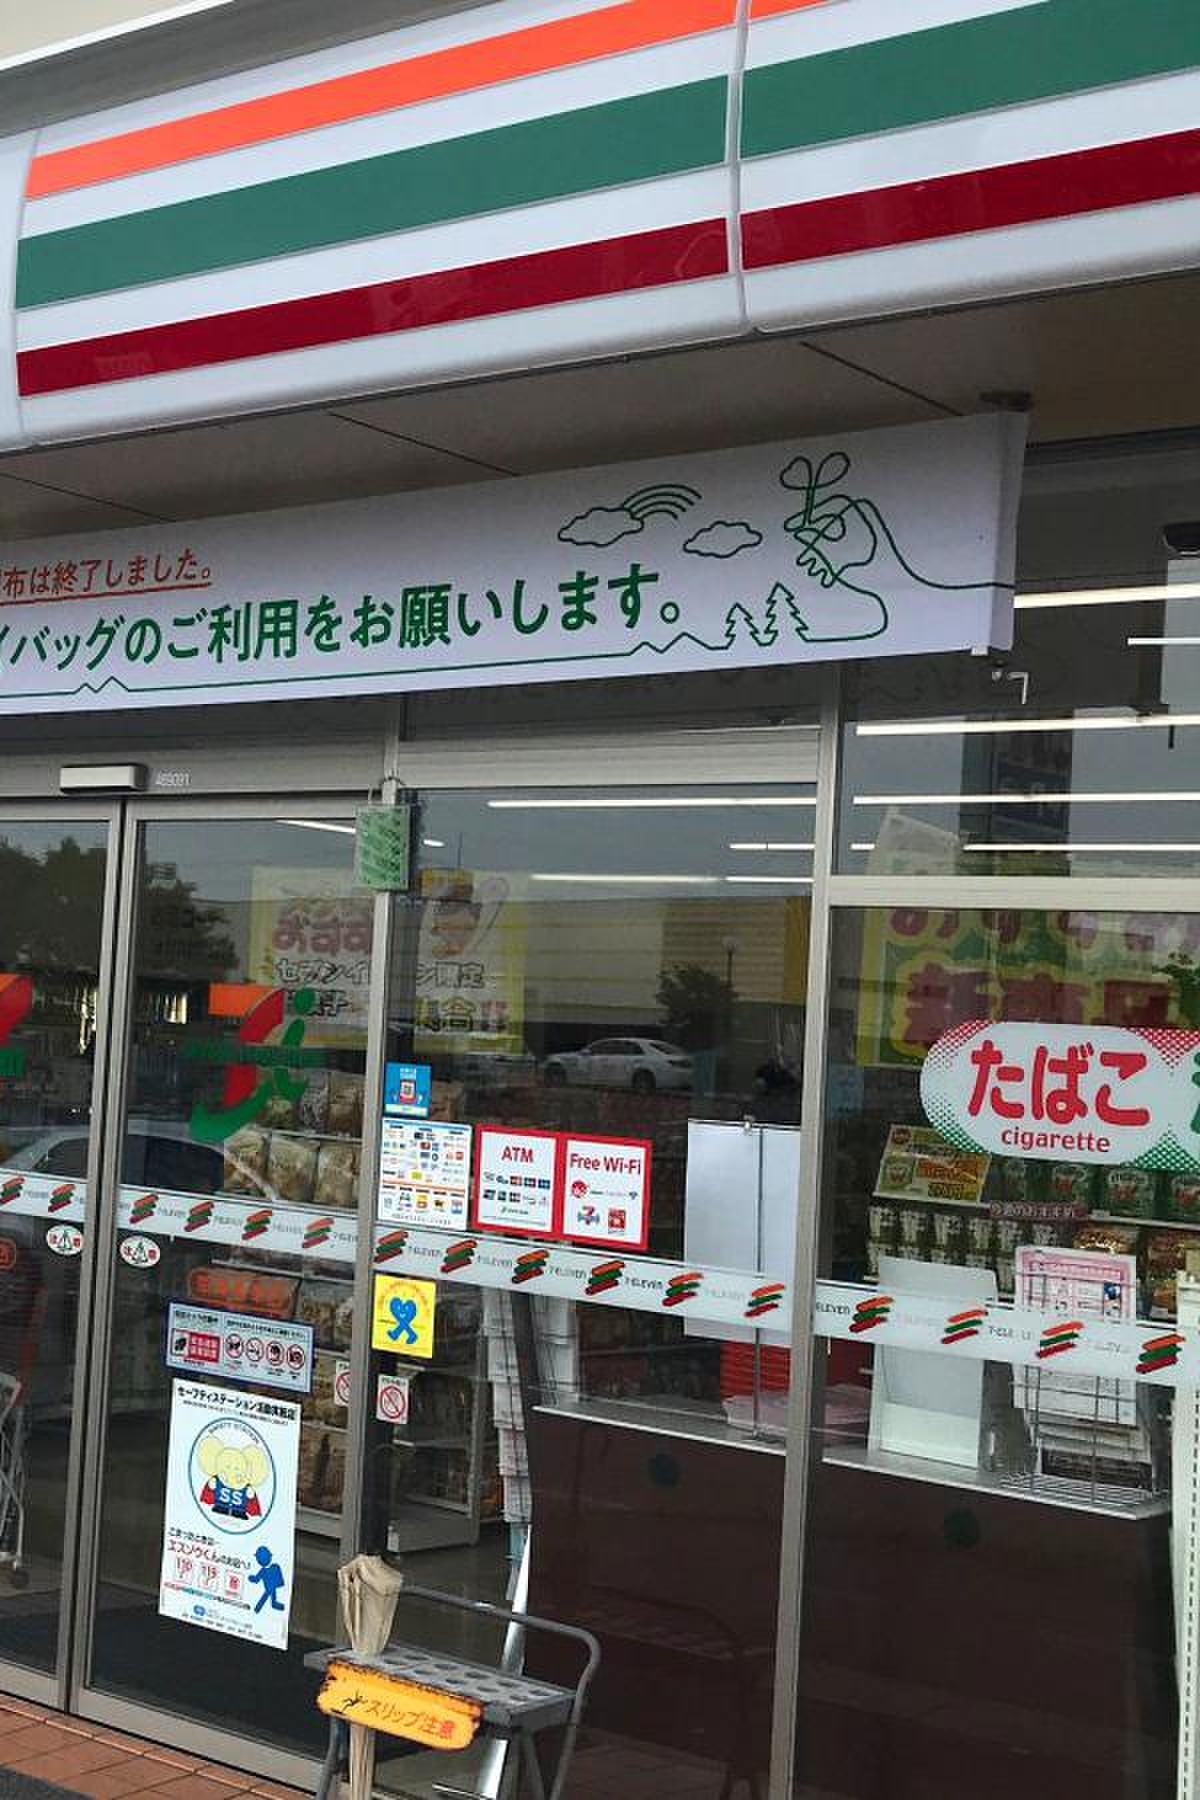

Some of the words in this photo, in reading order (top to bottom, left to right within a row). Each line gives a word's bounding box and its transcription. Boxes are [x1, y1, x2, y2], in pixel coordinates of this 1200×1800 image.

[967, 1039, 1150, 1127] たばこ
[1000, 1125, 1111, 1153] cigarette
[501, 1146, 534, 1164] ATM
[569, 1153, 601, 1172] Free
[603, 1156, 642, 1176] Wi-Fi
[219, 1487, 243, 1506] SS
[366, 1700, 456, 1738] スリップ注意
